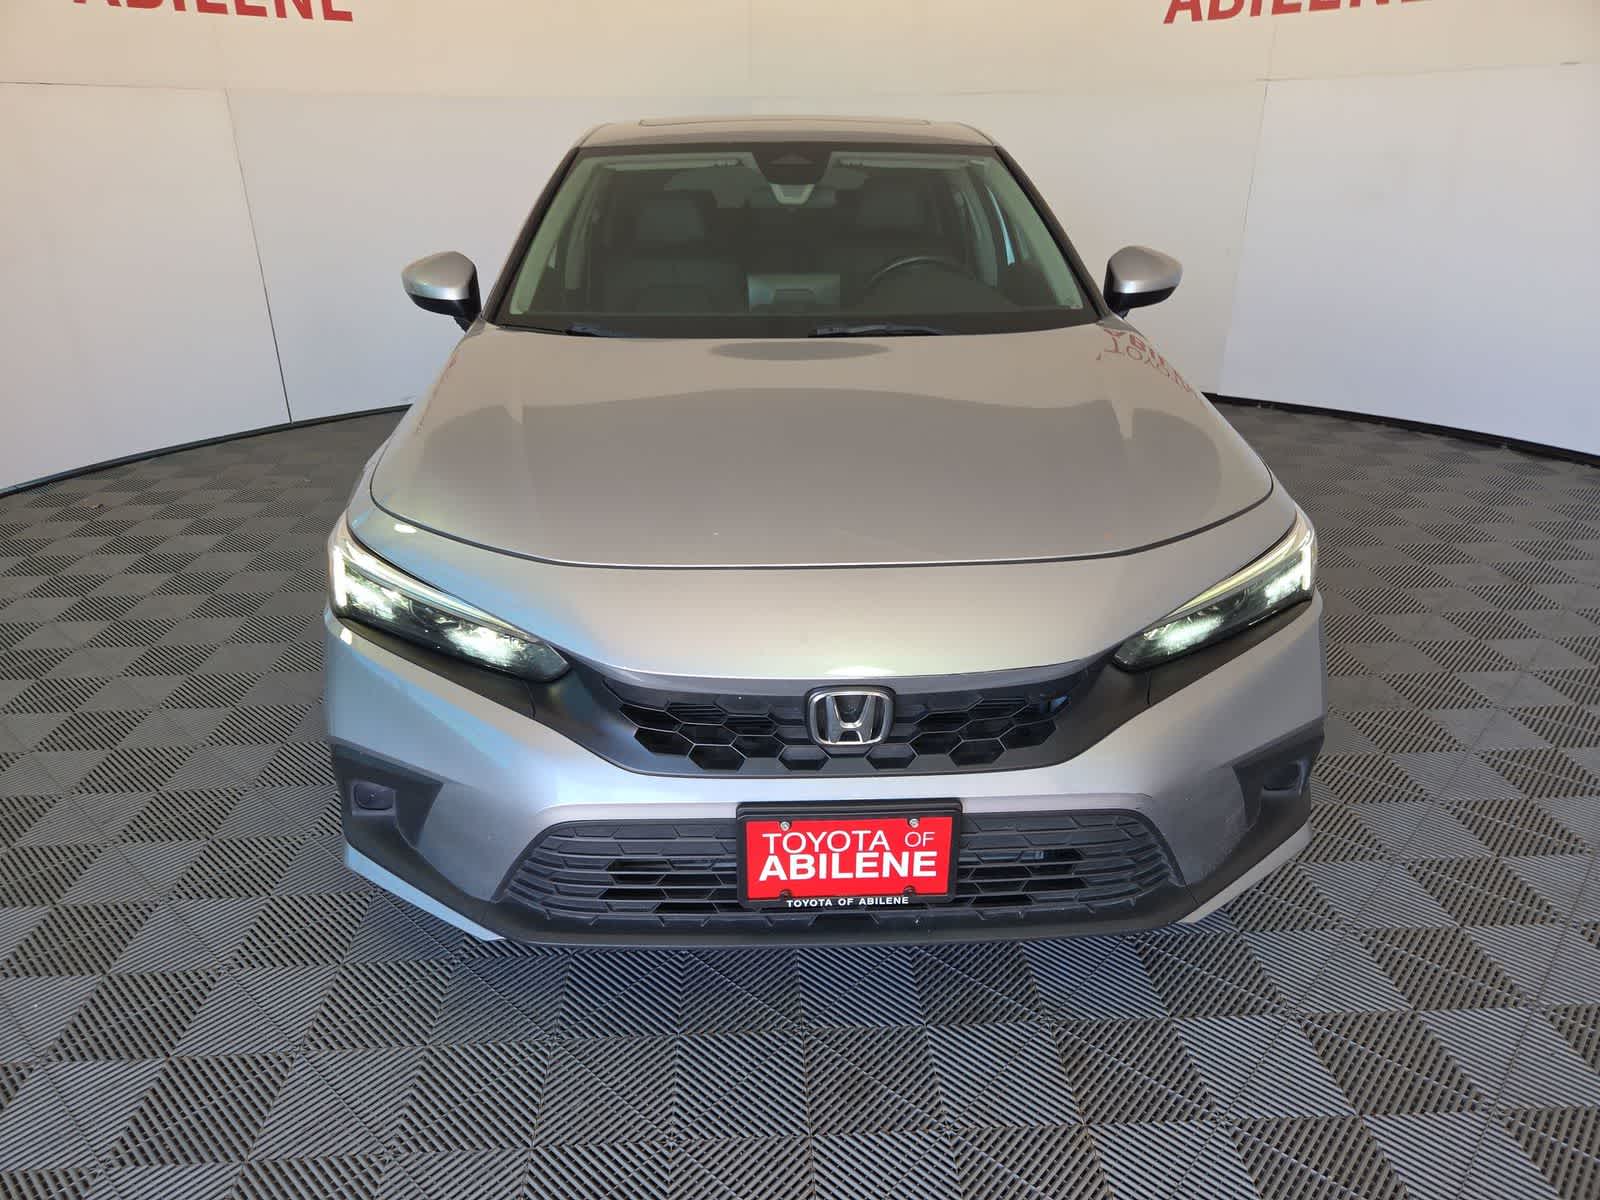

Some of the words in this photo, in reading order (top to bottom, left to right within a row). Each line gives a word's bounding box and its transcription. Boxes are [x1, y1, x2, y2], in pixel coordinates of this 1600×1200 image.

[762, 830, 890, 854] TOYOTA
[904, 831, 935, 847] OF
[759, 851, 938, 881] ABILENE
[787, 898, 833, 908] TOYOTA
[838, 897, 854, 906] OF
[859, 896, 909, 906] ABILENE
